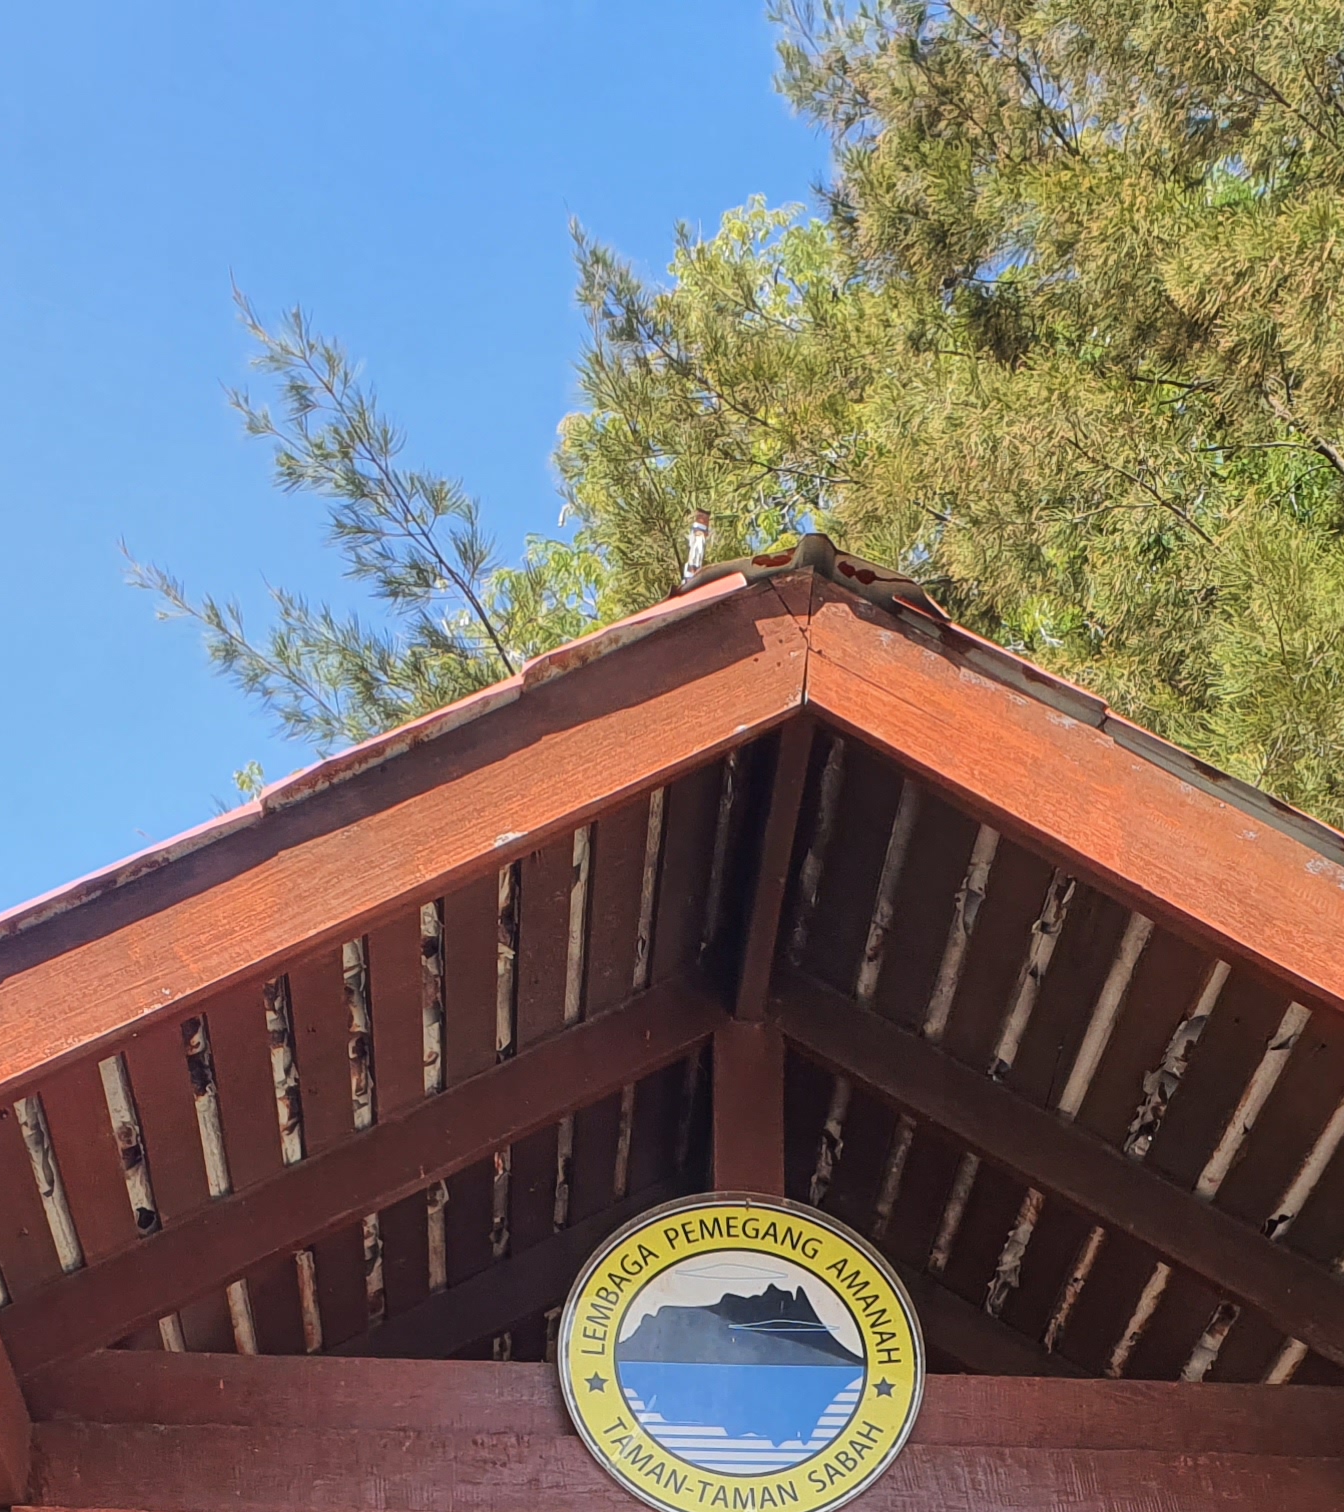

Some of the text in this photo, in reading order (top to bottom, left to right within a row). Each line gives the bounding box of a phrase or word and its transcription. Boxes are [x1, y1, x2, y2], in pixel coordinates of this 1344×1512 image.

[581, 1216, 902, 1365] LEMBAGA PEMEGANG AMANAH
[602, 1416, 885, 1510] TAMAN-TAMAN SABAH
